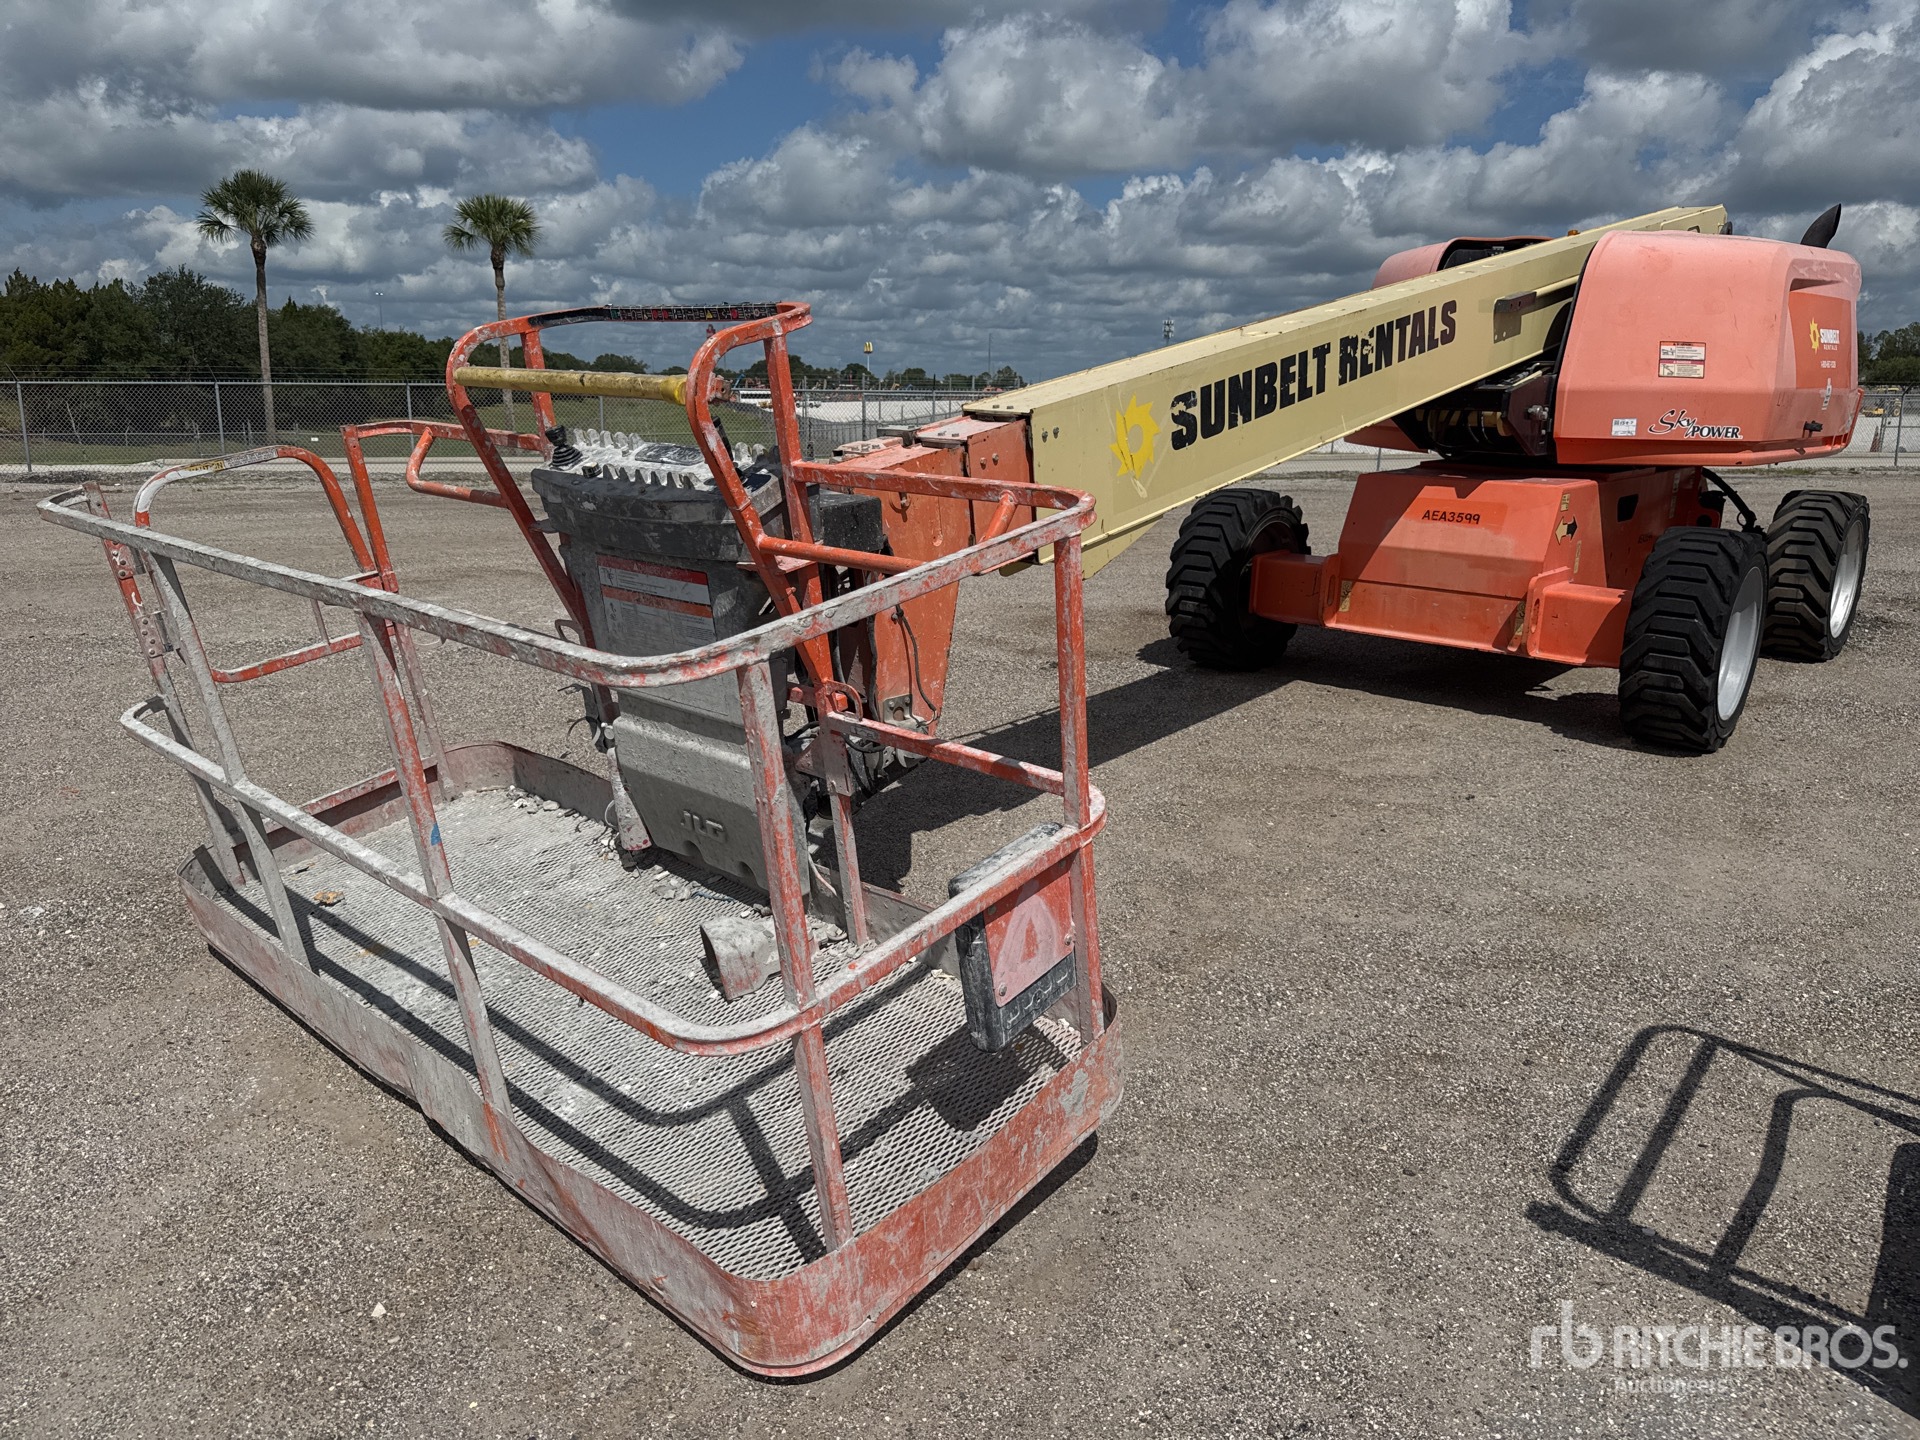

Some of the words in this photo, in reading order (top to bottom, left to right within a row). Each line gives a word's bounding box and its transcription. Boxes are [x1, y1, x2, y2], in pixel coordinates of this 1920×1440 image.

[1170, 341, 1331, 450] SUNBELT
[1338, 300, 1457, 386] RENTALS
[1648, 409, 1697, 439] Sky
[1690, 425, 1740, 439] POWER
[1421, 510, 1480, 525] AEA3599
